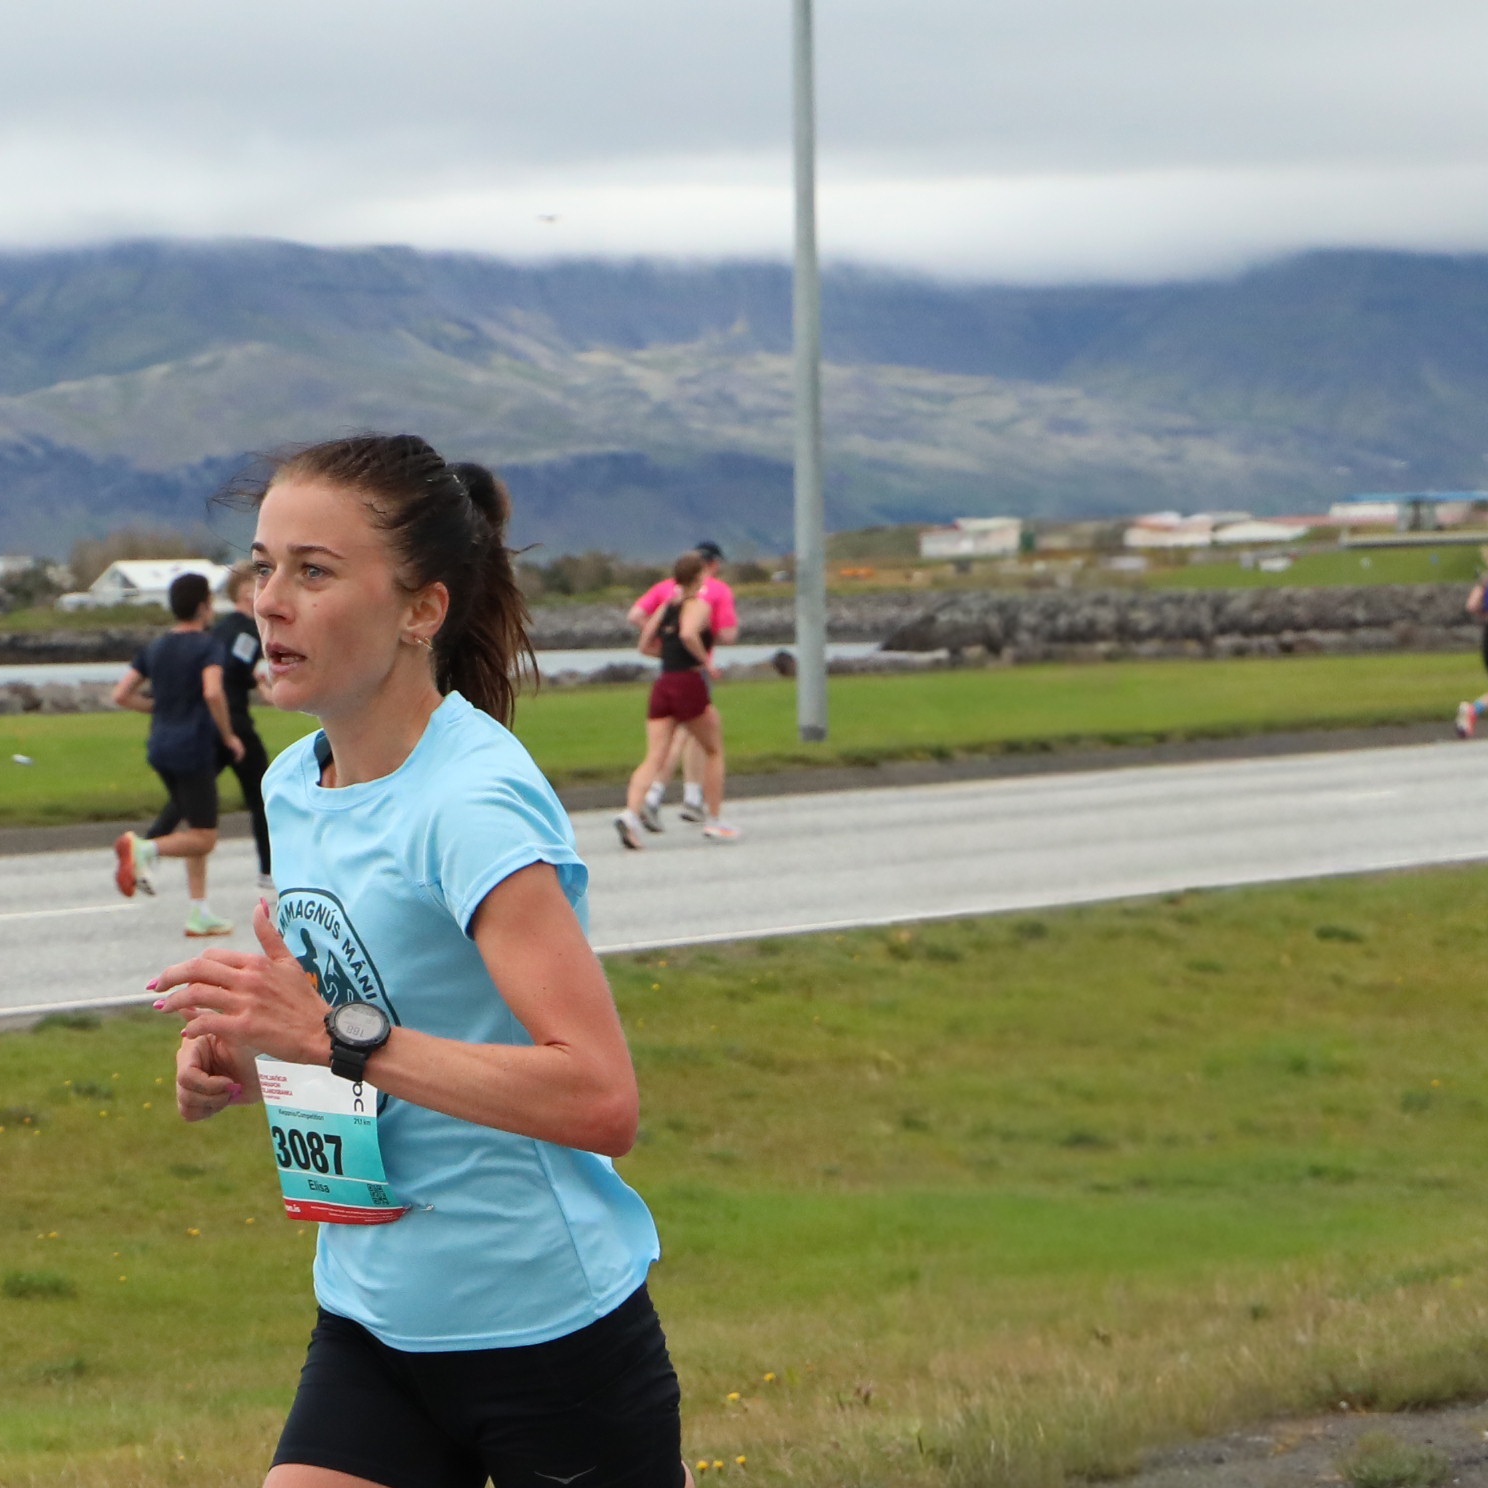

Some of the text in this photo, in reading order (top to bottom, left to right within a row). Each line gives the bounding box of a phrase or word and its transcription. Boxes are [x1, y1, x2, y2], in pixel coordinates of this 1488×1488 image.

[284, 899, 341, 940] MAGNÚS
[341, 938, 378, 1000] MÁNI
[272, 1126, 343, 1175] 3087
[308, 1179, 330, 1193] Elisa
